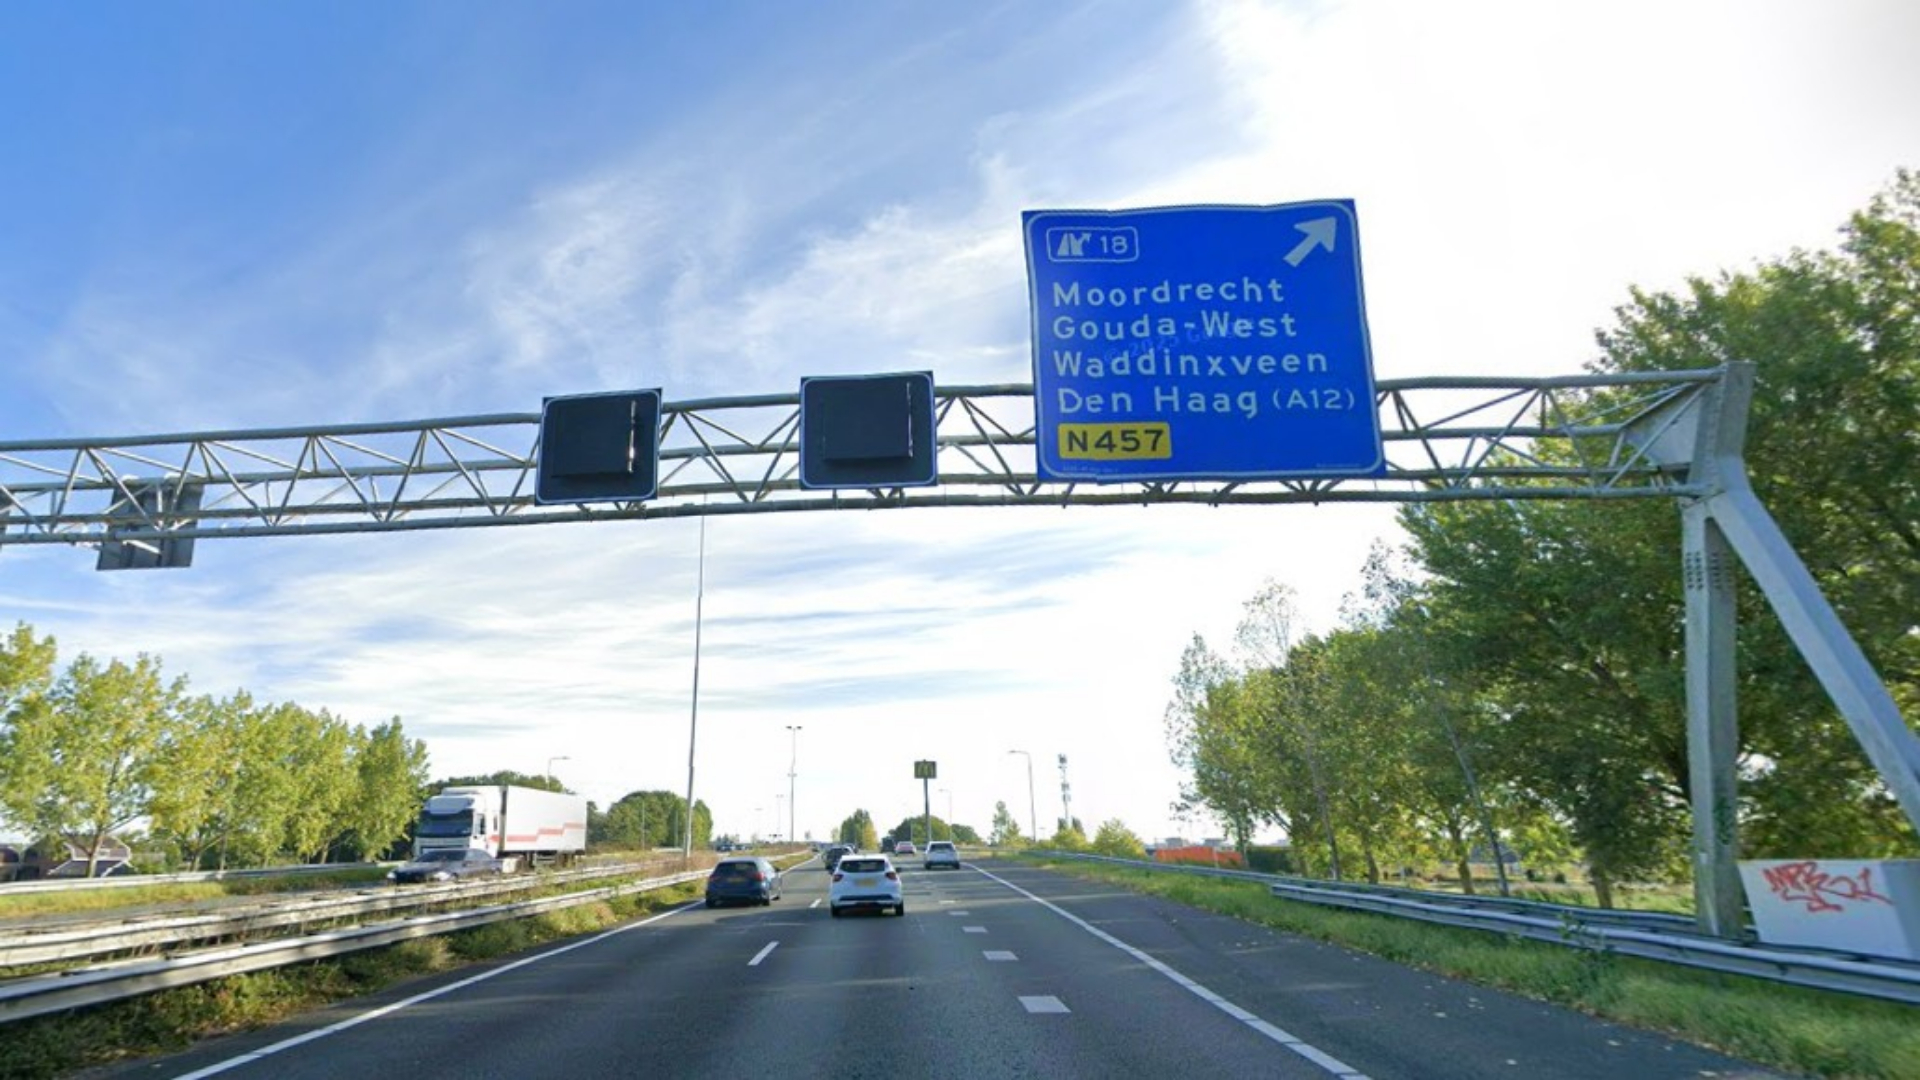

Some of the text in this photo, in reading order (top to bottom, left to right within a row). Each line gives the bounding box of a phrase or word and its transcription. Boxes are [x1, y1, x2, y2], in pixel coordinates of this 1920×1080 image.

[1100, 235, 1128, 255] 18
[1053, 277, 1284, 307] Moordrecht
[1053, 310, 1297, 341] Gouda-West
[1053, 349, 1328, 378] Waddinxveen
[1058, 386, 1355, 418] Den Haag (A12)
[1067, 429, 1165, 454] N457
